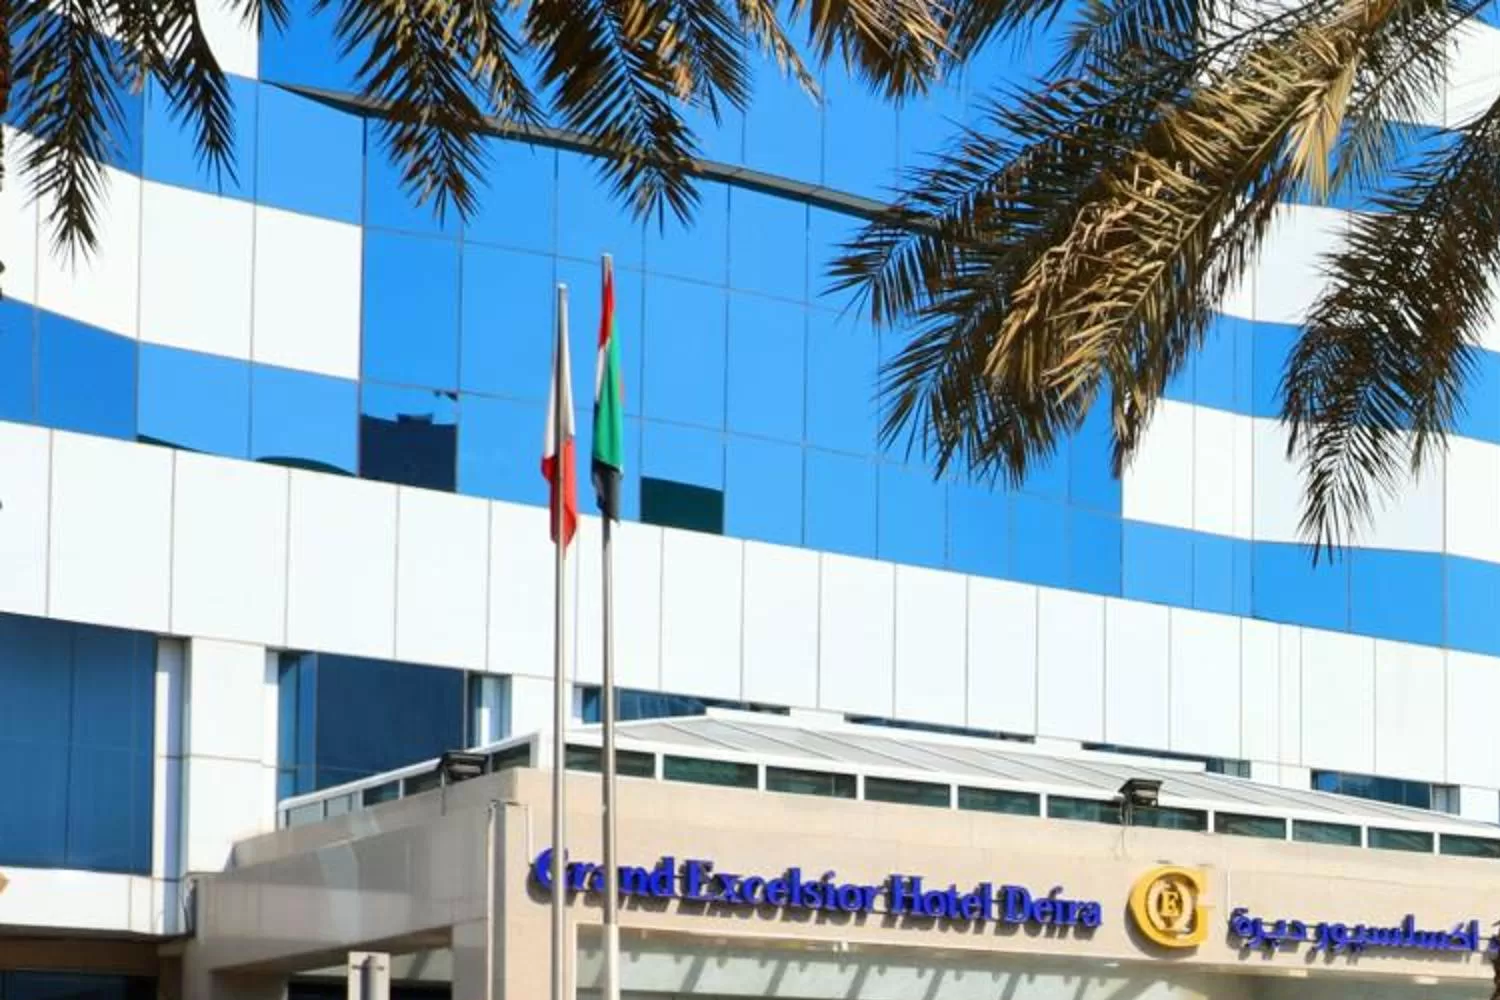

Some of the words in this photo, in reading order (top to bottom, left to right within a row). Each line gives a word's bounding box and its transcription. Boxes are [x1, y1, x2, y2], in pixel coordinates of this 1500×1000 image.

[534, 847, 676, 898] Grand
[684, 860, 878, 911] Excelsior
[886, 873, 993, 920] Hotel
[1001, 885, 1103, 928] Deira
